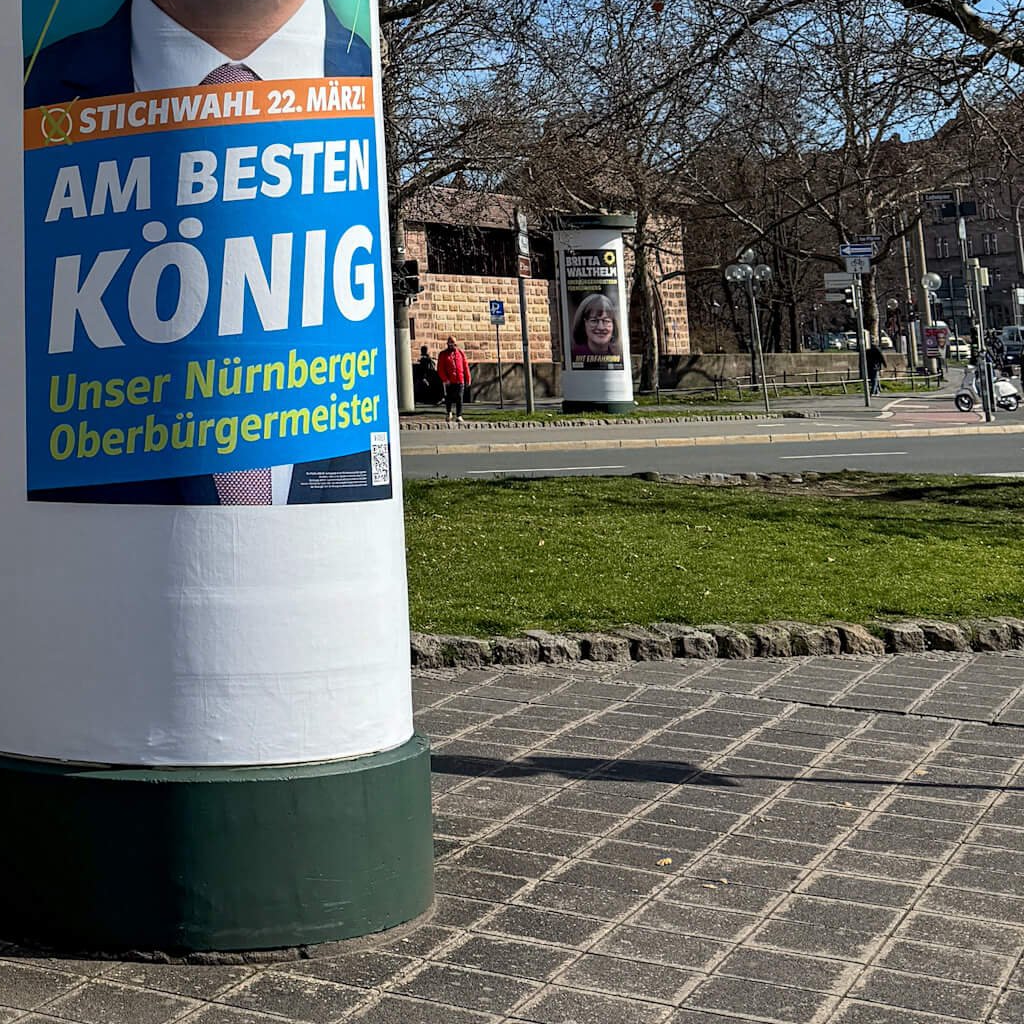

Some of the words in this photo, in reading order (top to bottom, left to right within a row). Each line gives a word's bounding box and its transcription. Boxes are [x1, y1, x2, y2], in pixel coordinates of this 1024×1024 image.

[80, 90, 260, 133] STICHWAHL
[267, 90, 302, 115] 22.
[307, 81, 365, 112] MÄRZ!
[45, 157, 151, 223] AM
[176, 139, 369, 207] BESTEN
[47, 218, 375, 354] KÖNIG
[566, 255, 601, 266] BRITTA
[49, 373, 171, 413] Unser
[186, 346, 378, 401] Nürnberger
[50, 393, 380, 461] Oberbürgermeister
